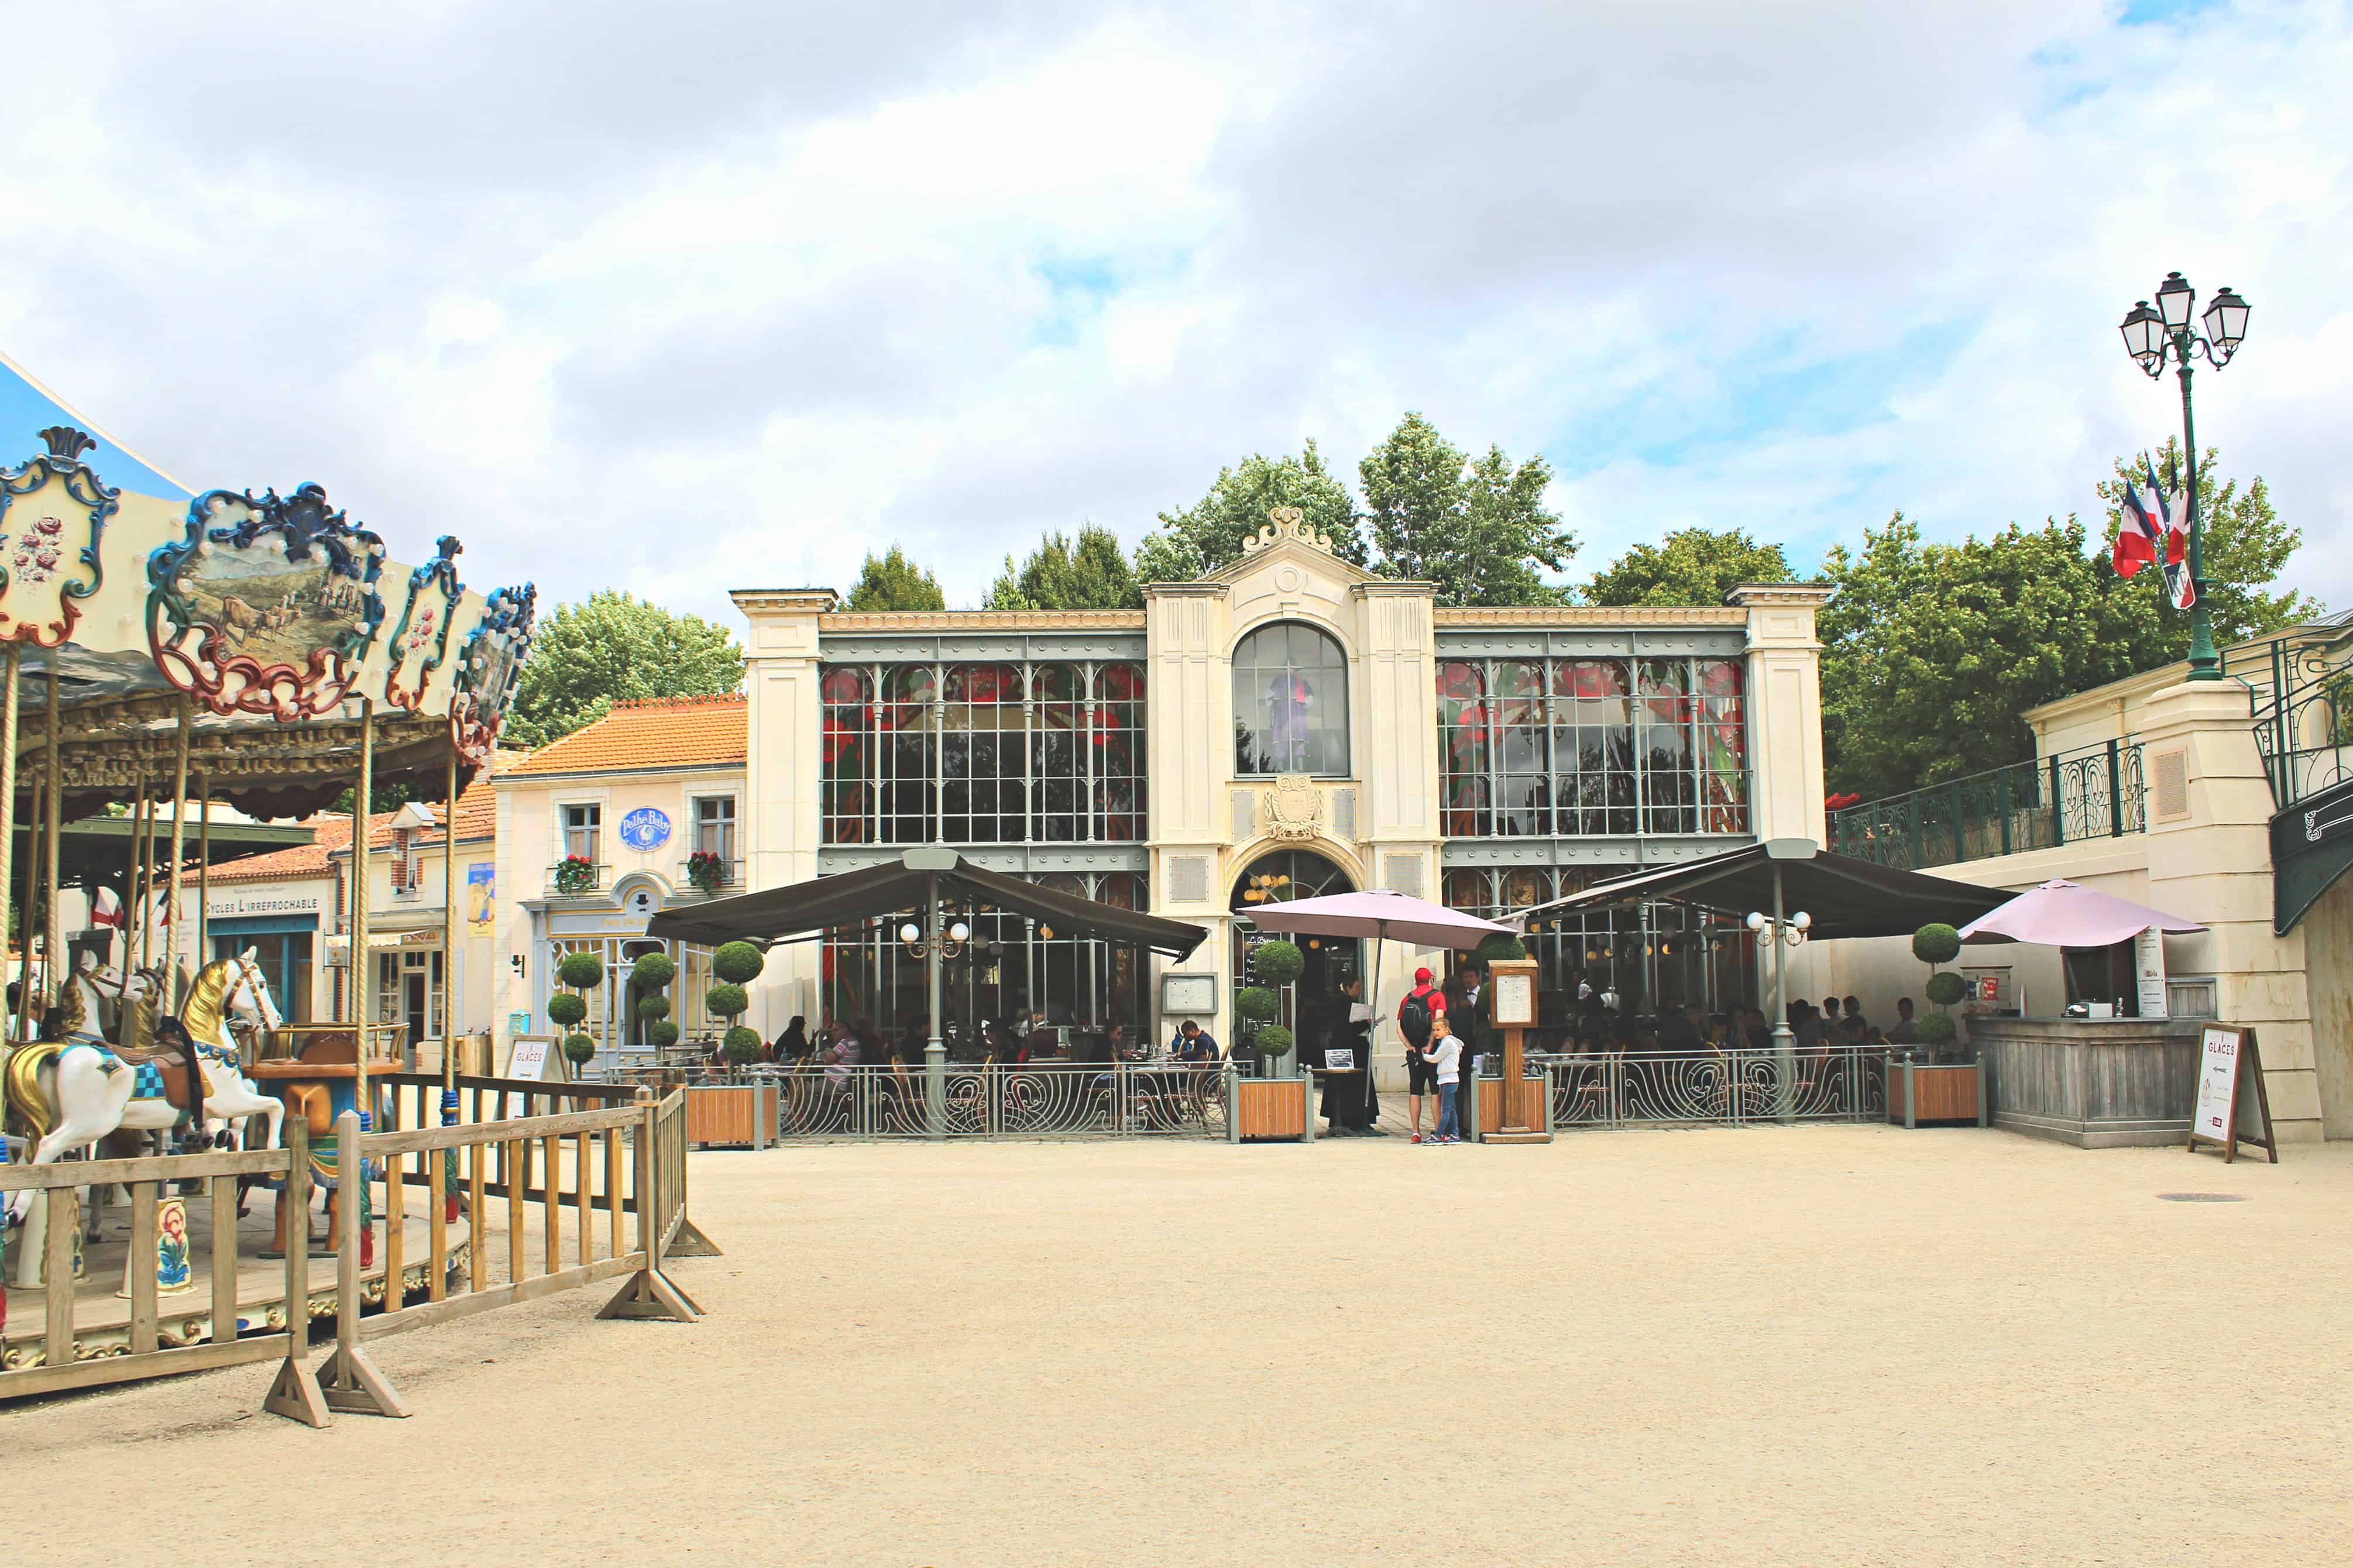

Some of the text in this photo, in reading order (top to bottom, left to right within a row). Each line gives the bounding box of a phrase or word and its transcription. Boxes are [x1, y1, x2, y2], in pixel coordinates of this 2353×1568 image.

[2167, 570, 2190, 597] RF
[2208, 1042, 2235, 1056] GLACES
[517, 1053, 542, 1062] GLACES
